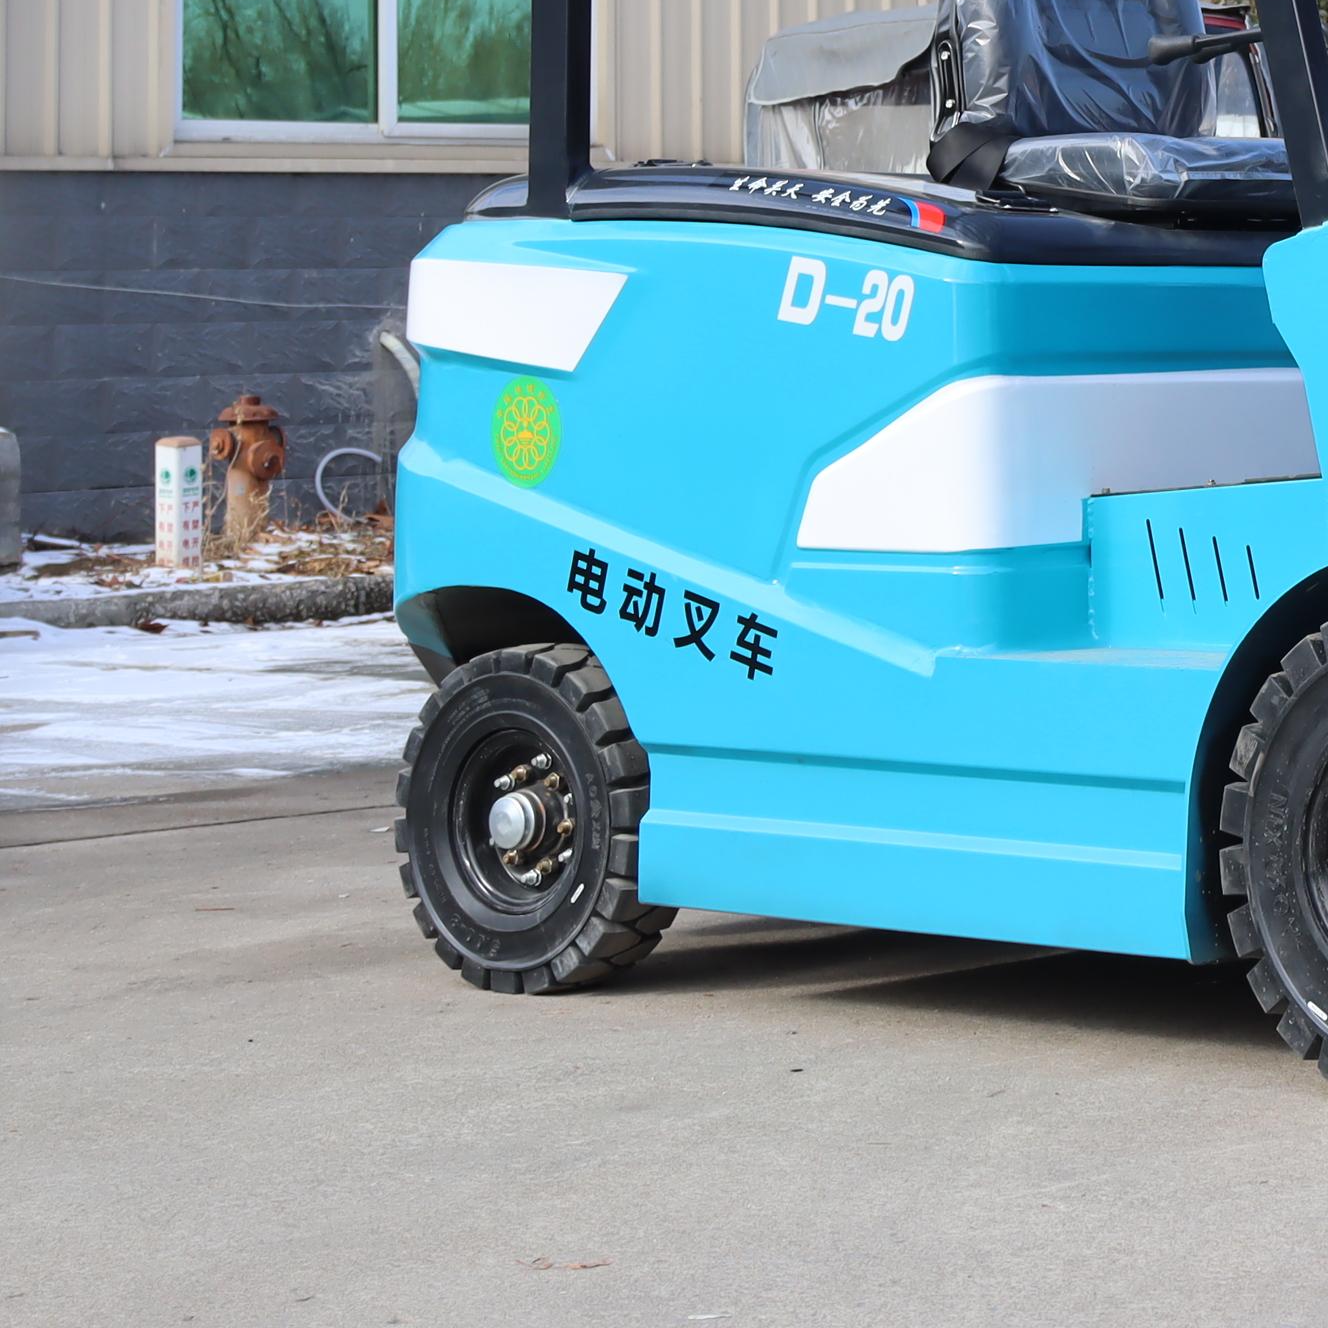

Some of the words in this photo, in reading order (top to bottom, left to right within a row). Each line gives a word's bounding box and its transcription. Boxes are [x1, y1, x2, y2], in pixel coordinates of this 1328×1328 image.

[777, 255, 914, 342] D-20
[566, 546, 779, 682] 电动叉车
